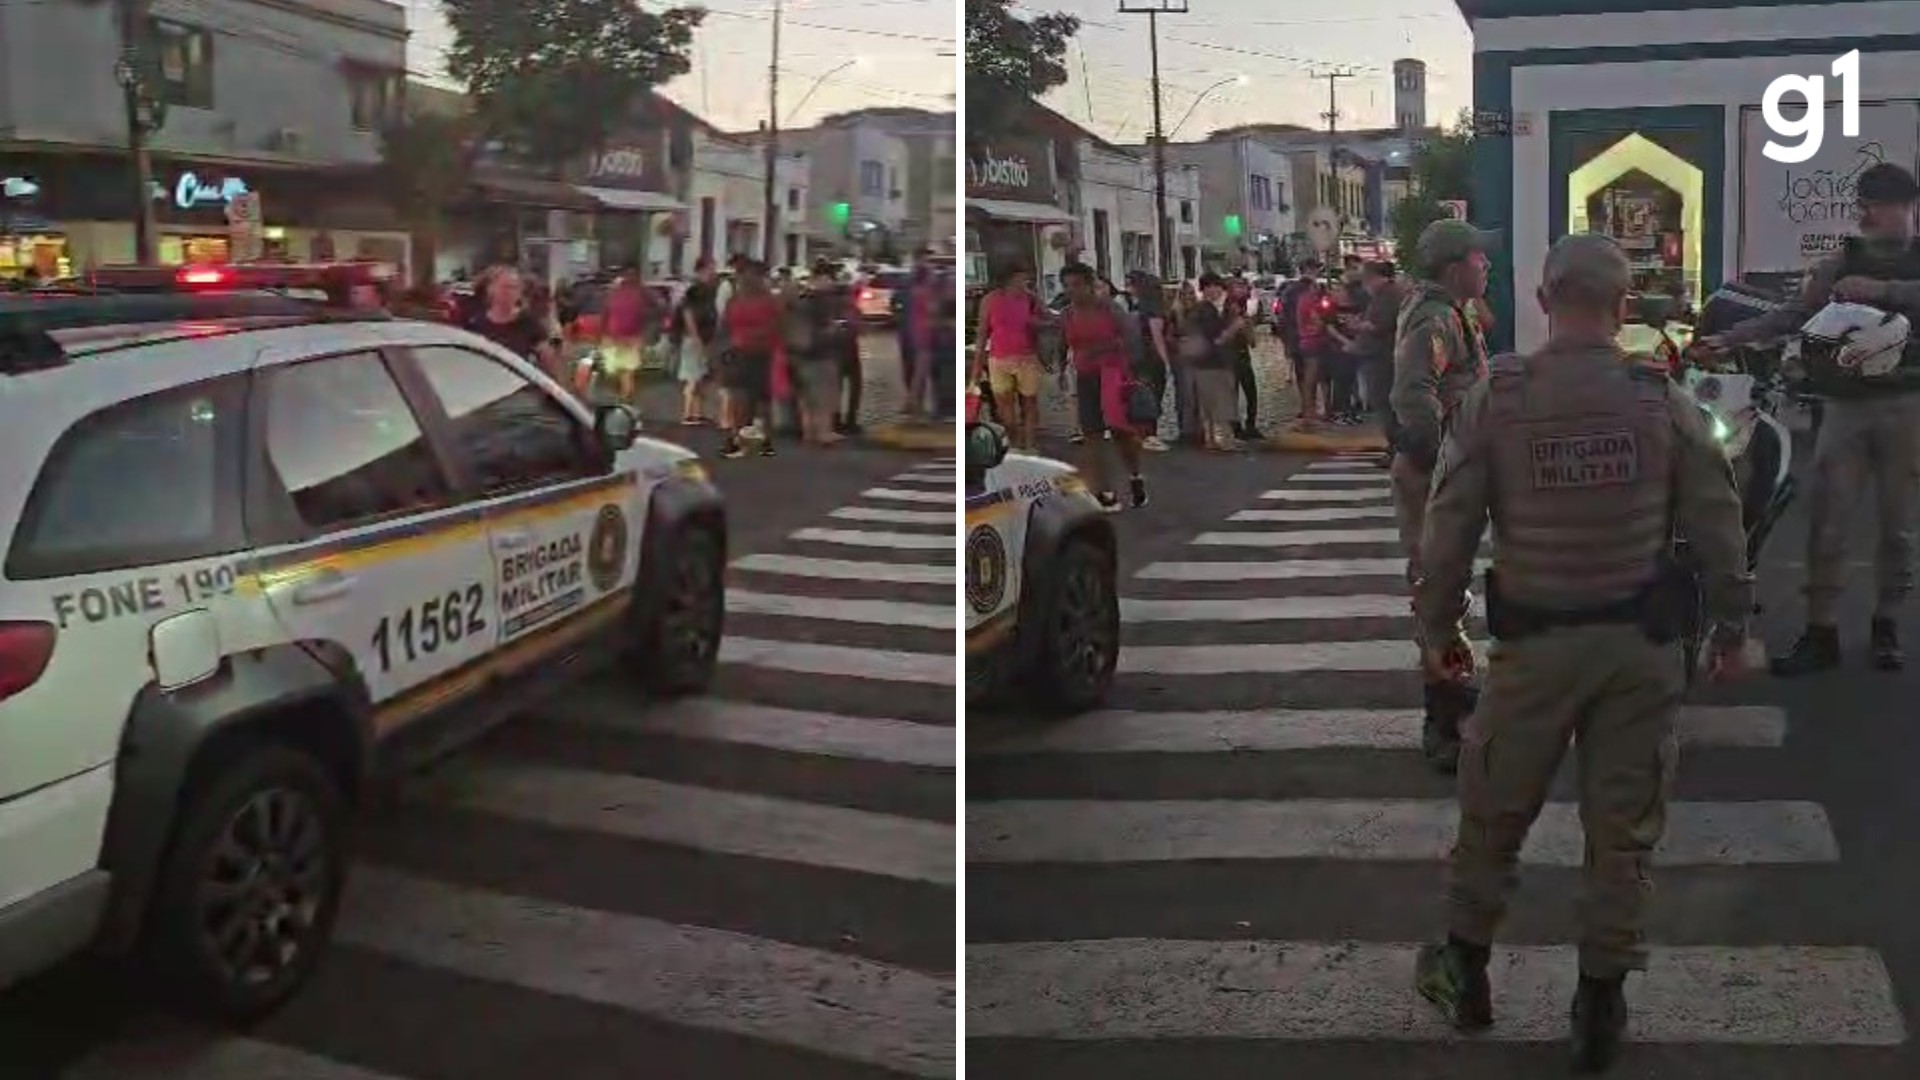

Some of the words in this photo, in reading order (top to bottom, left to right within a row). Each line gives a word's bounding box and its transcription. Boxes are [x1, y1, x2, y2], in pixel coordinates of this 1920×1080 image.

[1535, 437, 1634, 462] BRIGADA
[1541, 462, 1630, 484] MILITAR
[502, 533, 582, 583] BRIGADA
[52, 577, 165, 629] FONE
[174, 564, 234, 603] 190
[501, 561, 583, 613] MILITAR
[371, 582, 486, 672] 11562
